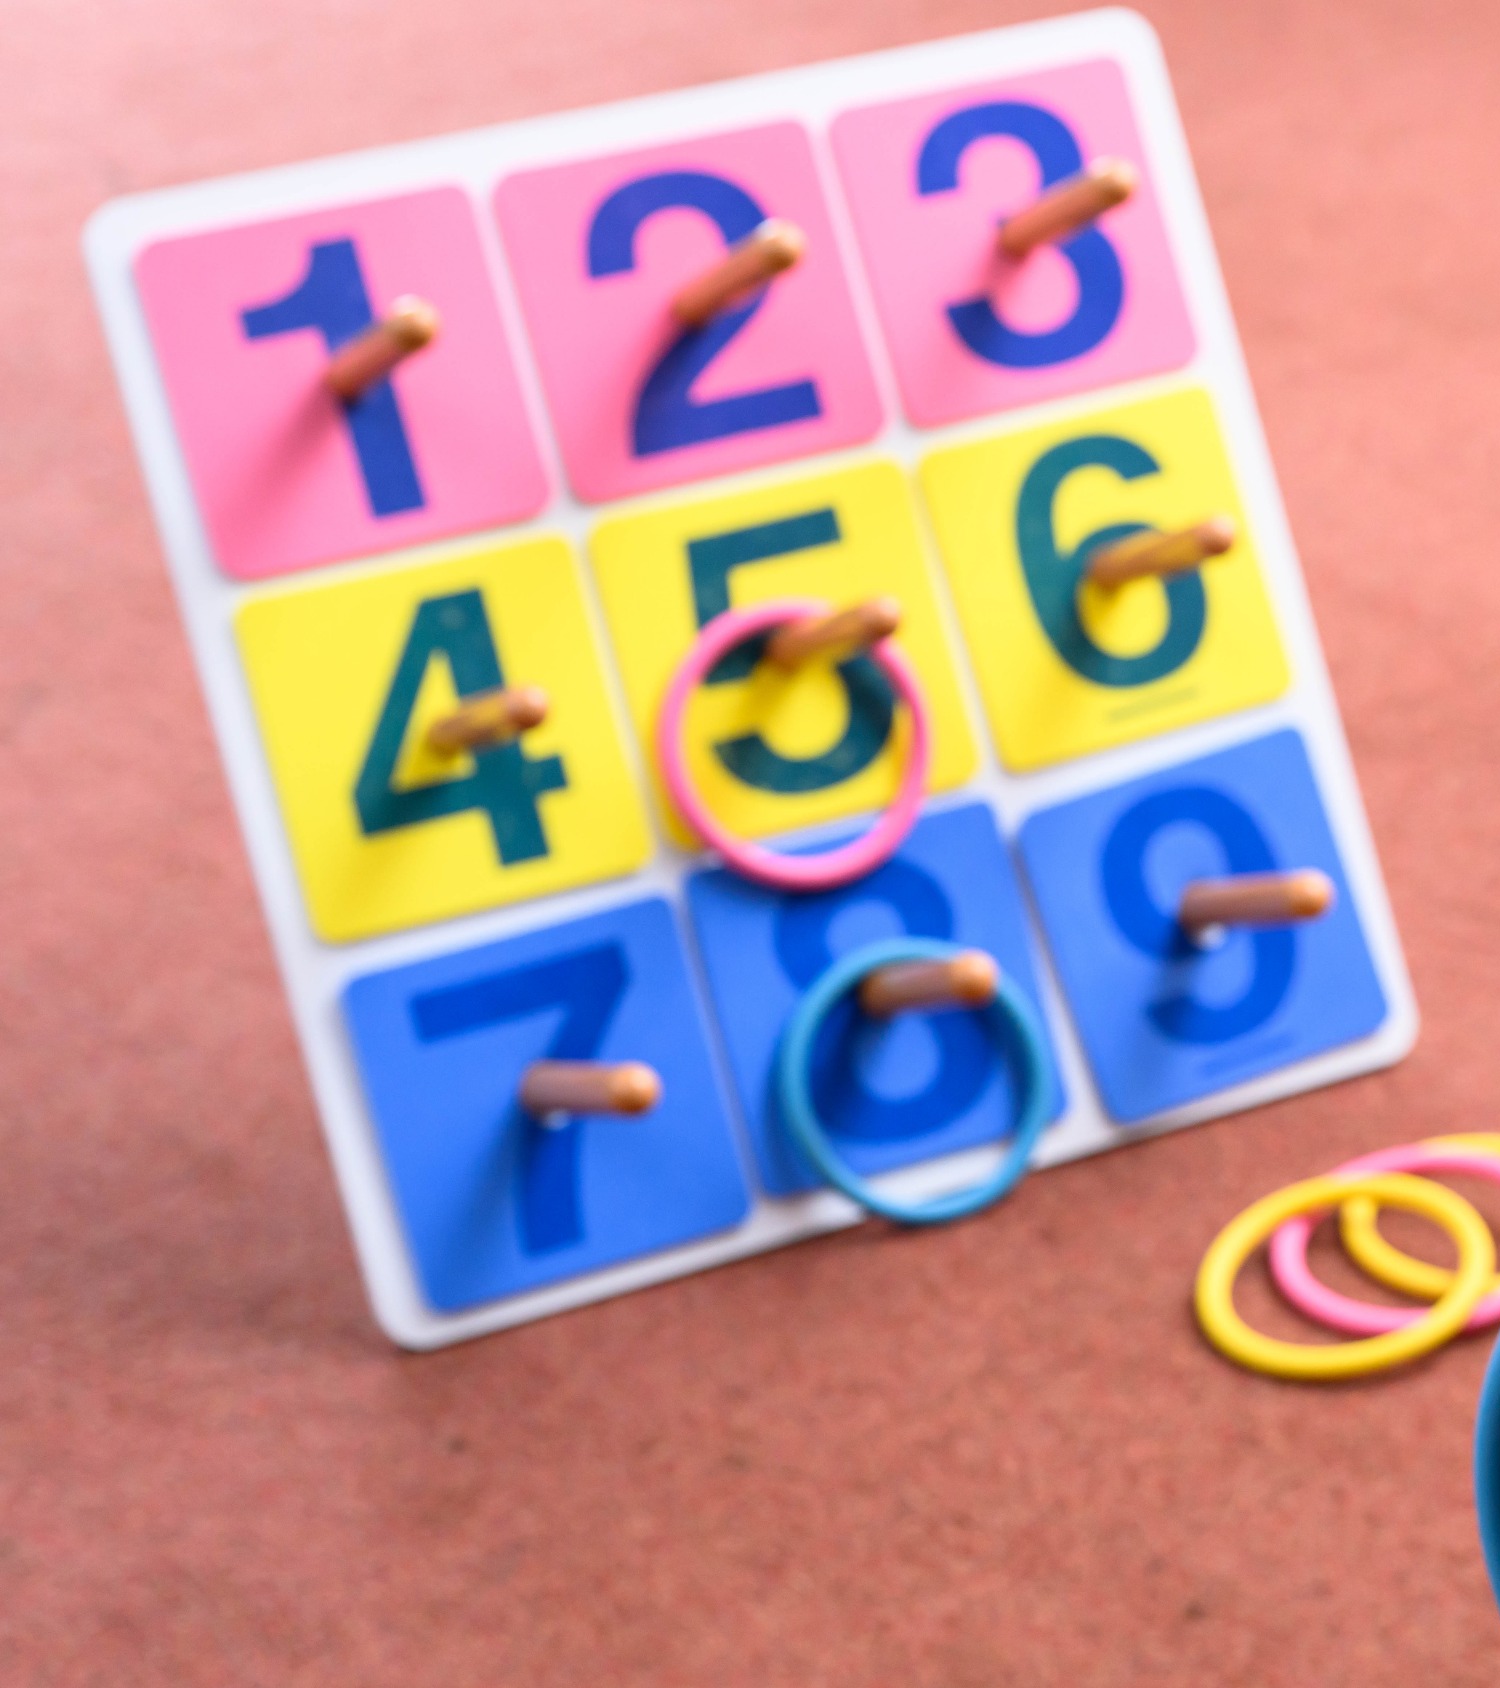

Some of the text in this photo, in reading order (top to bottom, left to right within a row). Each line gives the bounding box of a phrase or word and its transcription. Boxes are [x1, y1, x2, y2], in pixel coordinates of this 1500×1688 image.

[241, 101, 1124, 519] 1 2 3
[353, 434, 1208, 868] 4 5 6
[411, 784, 1297, 1258] 7 8 9
